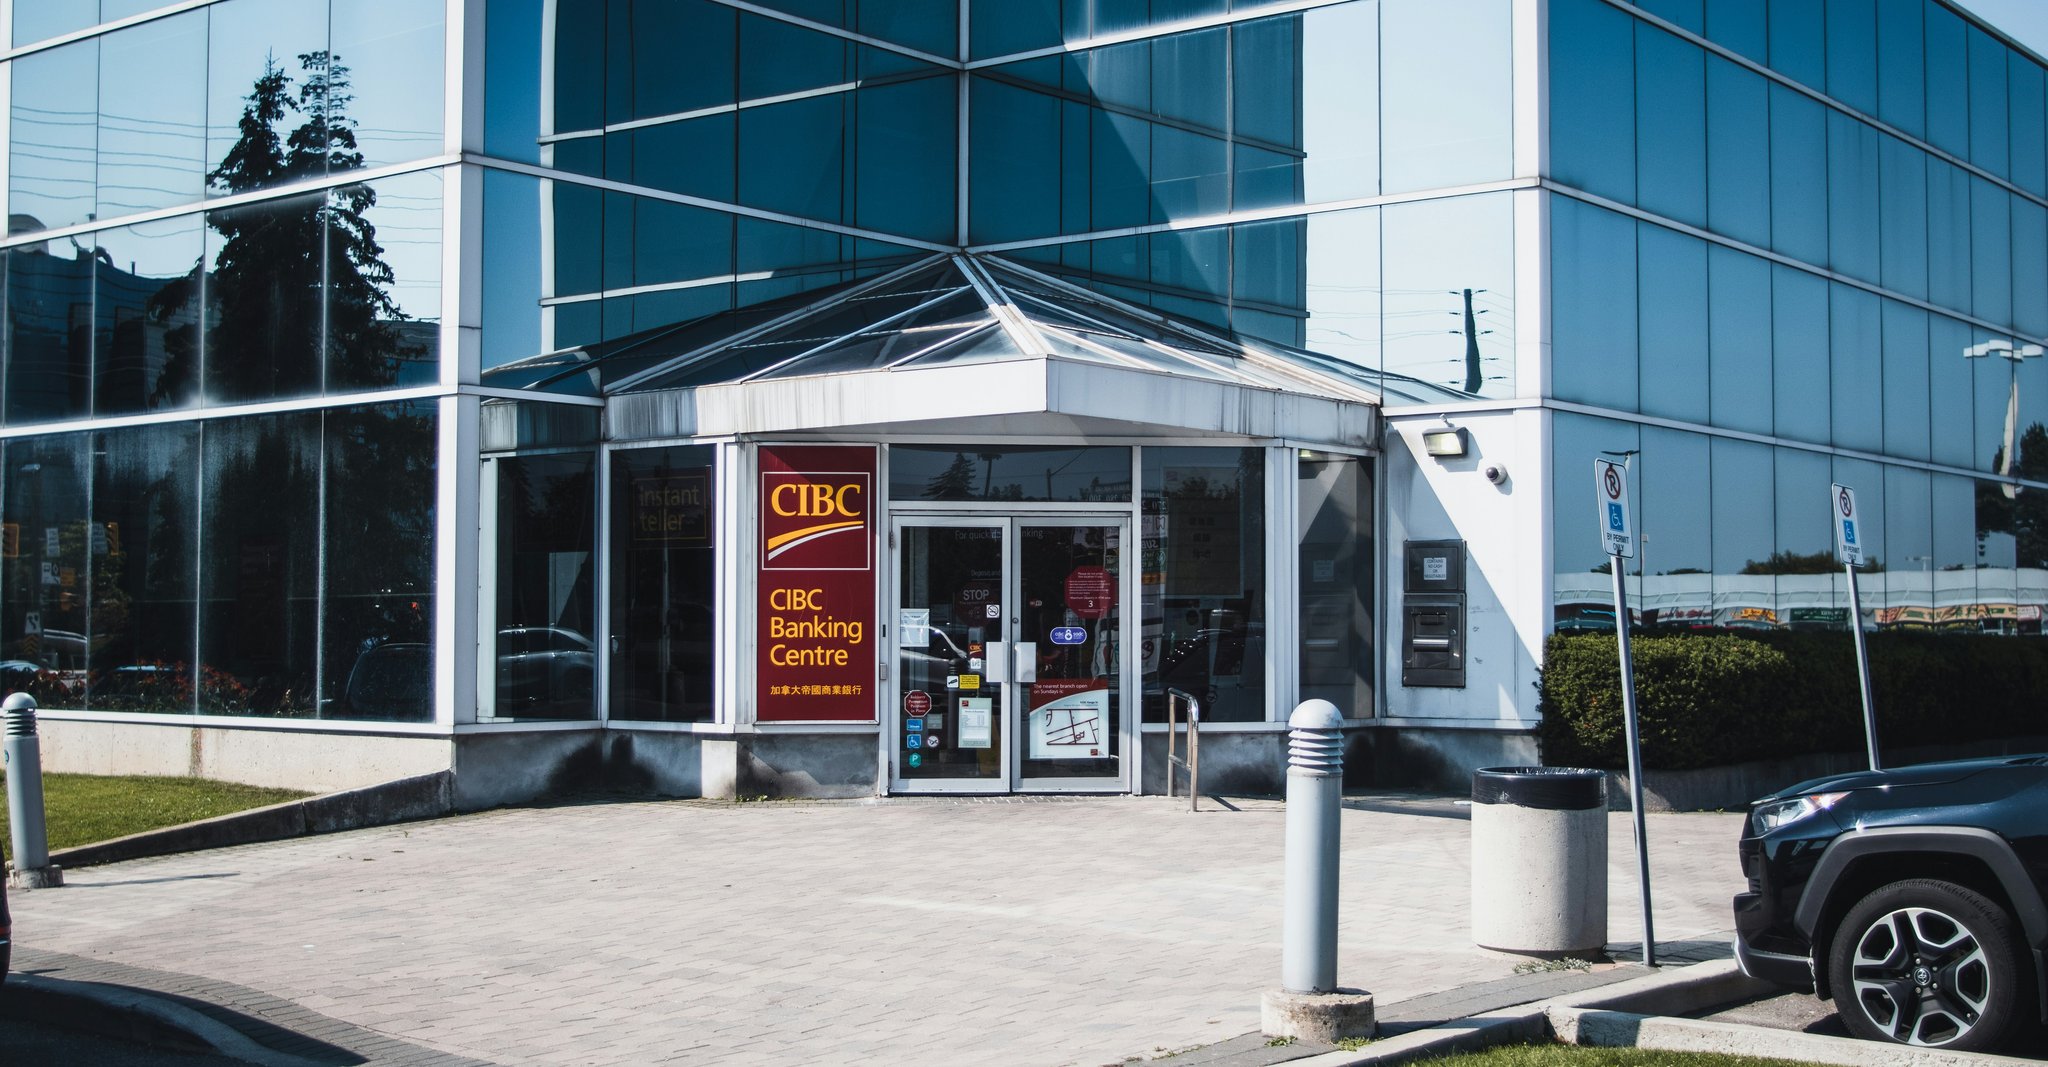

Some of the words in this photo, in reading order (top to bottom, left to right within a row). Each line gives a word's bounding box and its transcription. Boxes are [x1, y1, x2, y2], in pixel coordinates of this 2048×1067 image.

[640, 484, 700, 506] instant
[771, 484, 860, 516] CIBC
[640, 508, 686, 532] teller
[1022, 528, 1044, 540] nking
[1606, 532, 1612, 541] BY
[1613, 533, 1629, 544] PERMIT
[1612, 543, 1624, 552] ONLY
[770, 588, 822, 611] CIBC
[963, 589, 990, 601] STOP
[770, 615, 862, 643] Banking
[770, 644, 848, 666] Centre
[770, 685, 862, 696] 加拿大帝國商業銀行
